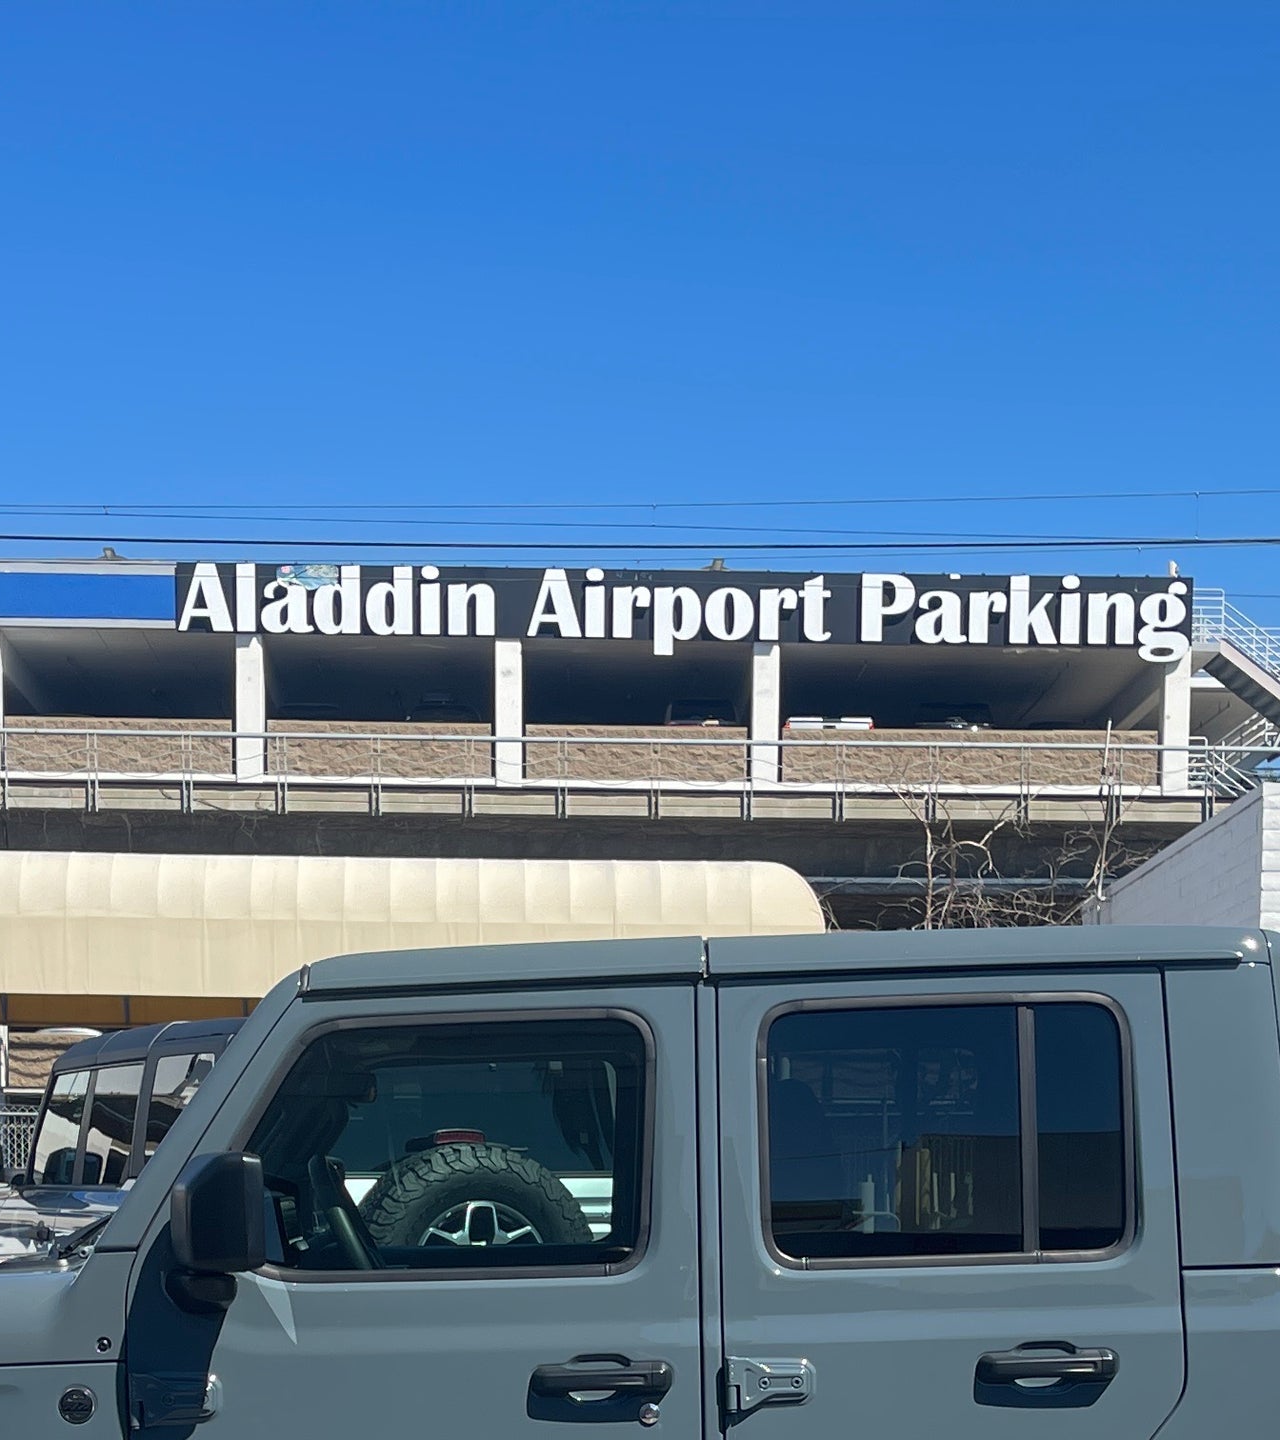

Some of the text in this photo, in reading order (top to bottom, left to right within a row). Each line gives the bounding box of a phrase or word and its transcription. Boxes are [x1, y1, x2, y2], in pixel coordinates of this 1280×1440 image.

[177, 562, 1190, 663] Aladdin Airport Parking
